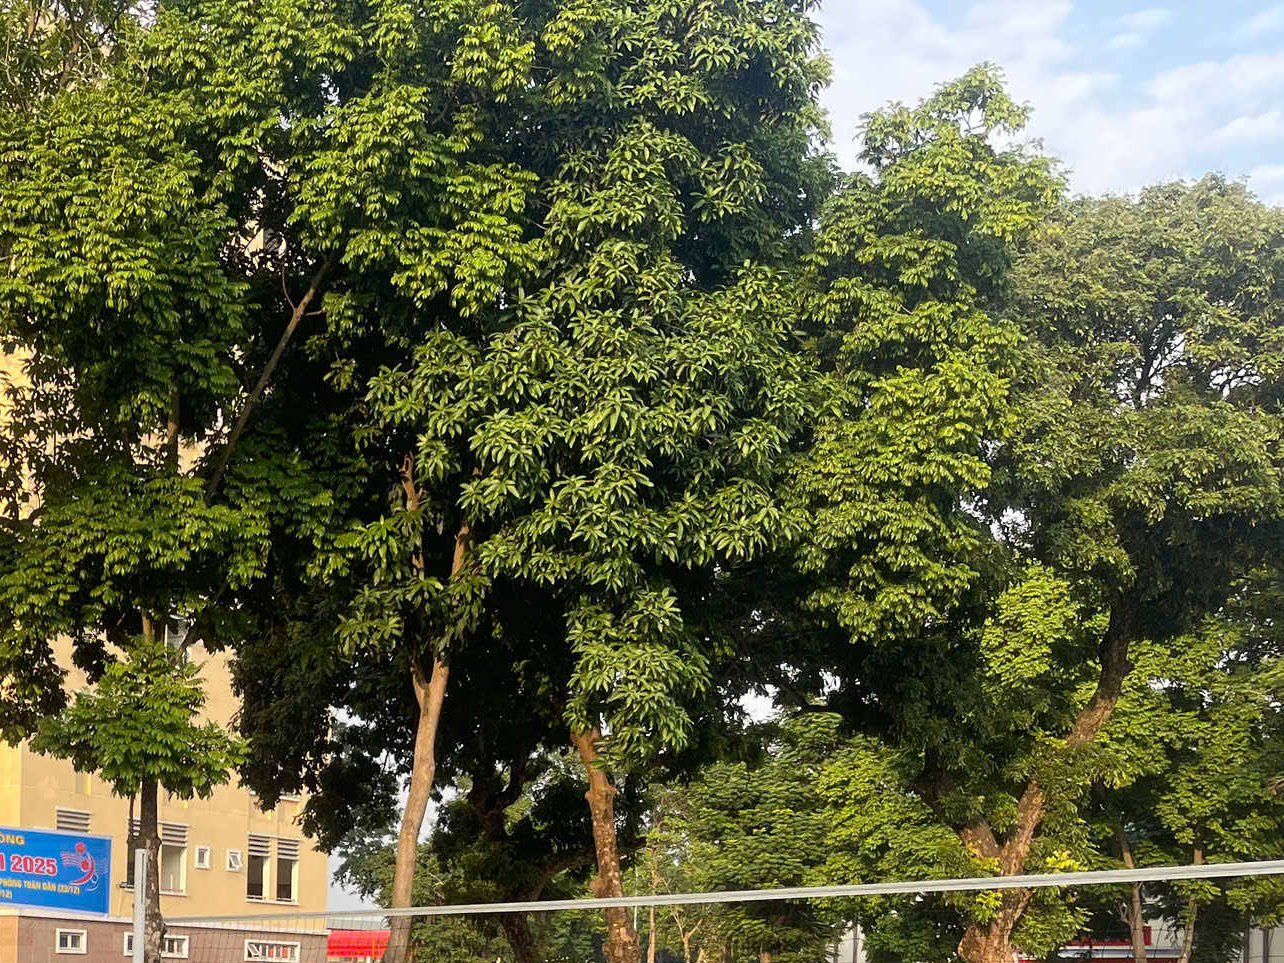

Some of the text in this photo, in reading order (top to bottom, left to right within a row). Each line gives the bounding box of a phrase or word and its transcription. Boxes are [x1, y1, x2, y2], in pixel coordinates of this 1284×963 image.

[11, 855, 57, 876] 2025
[0, 878, 21, 888] PHÒNG
[24, 880, 41, 889] TOÀN
